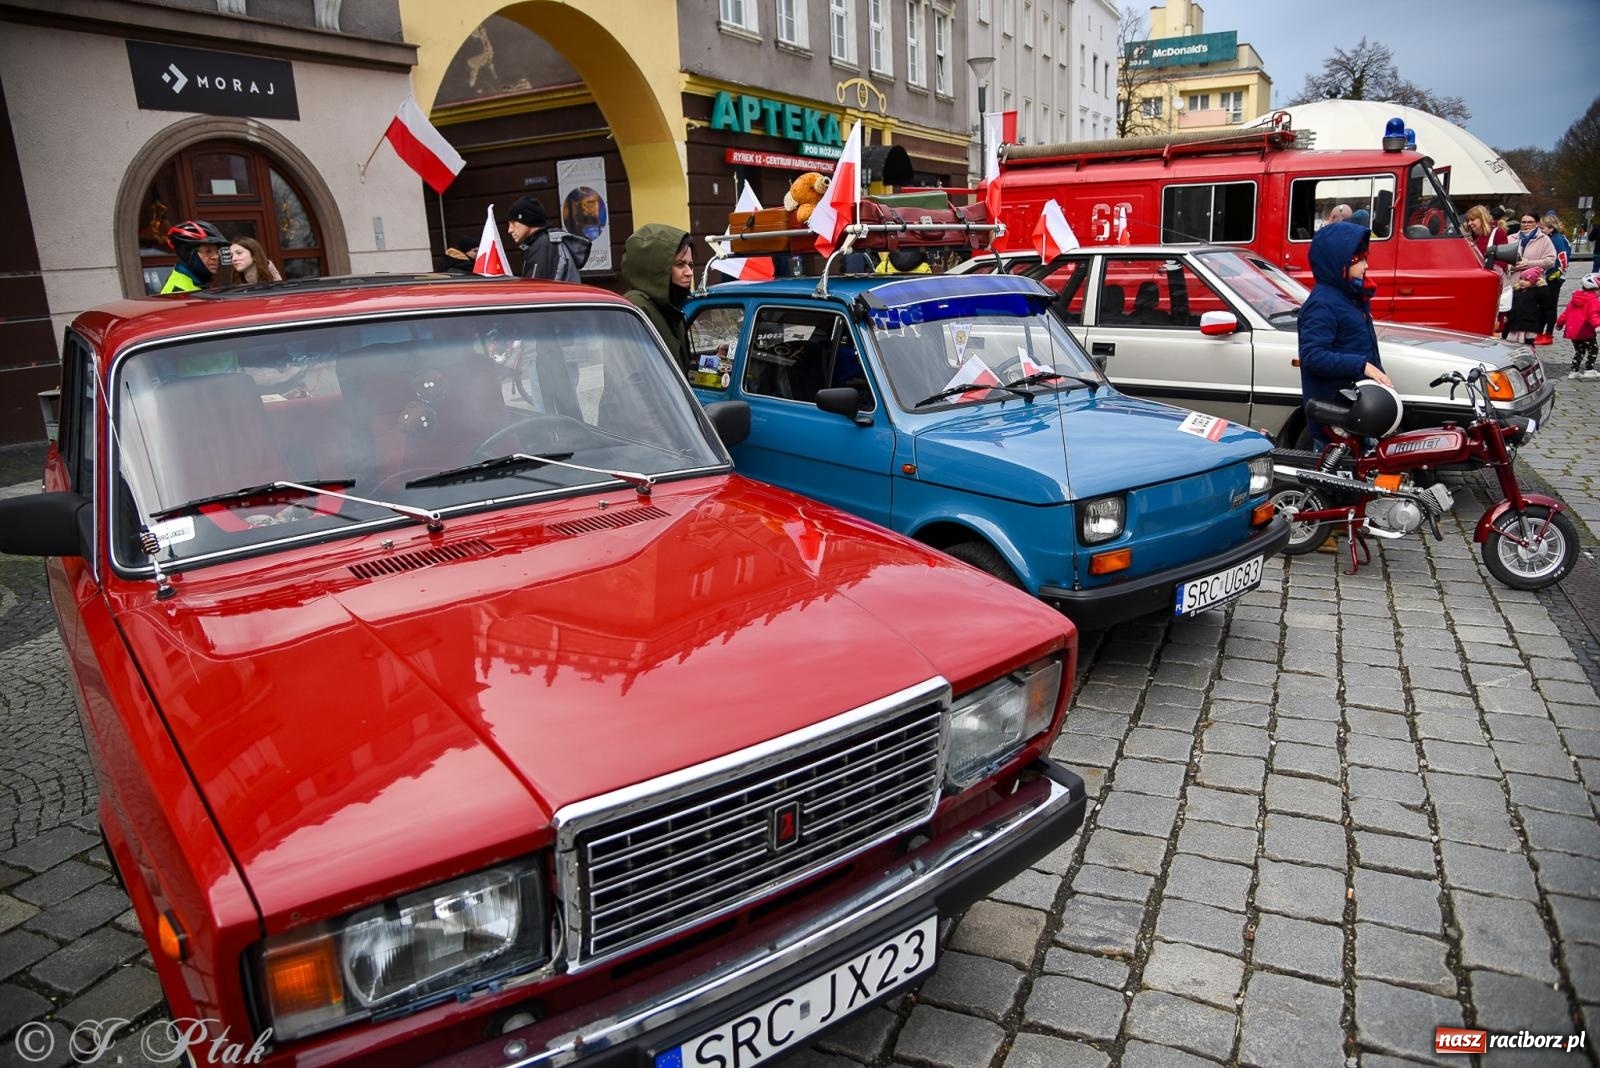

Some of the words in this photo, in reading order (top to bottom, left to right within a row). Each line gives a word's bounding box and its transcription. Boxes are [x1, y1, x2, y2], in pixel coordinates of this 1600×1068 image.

[1152, 44, 1208, 58] McDonald's
[196, 74, 275, 95] MORAJ
[710, 91, 842, 146] APTEKA
[733, 152, 754, 163] RYNEK
[755, 155, 762, 164] 12
[766, 156, 792, 167] CENTRUM
[804, 145, 819, 155] POD
[1187, 576, 1220, 609] SRC
[1224, 559, 1260, 595] UG83
[695, 998, 795, 1068] SRC
[819, 929, 926, 1024] JX23
